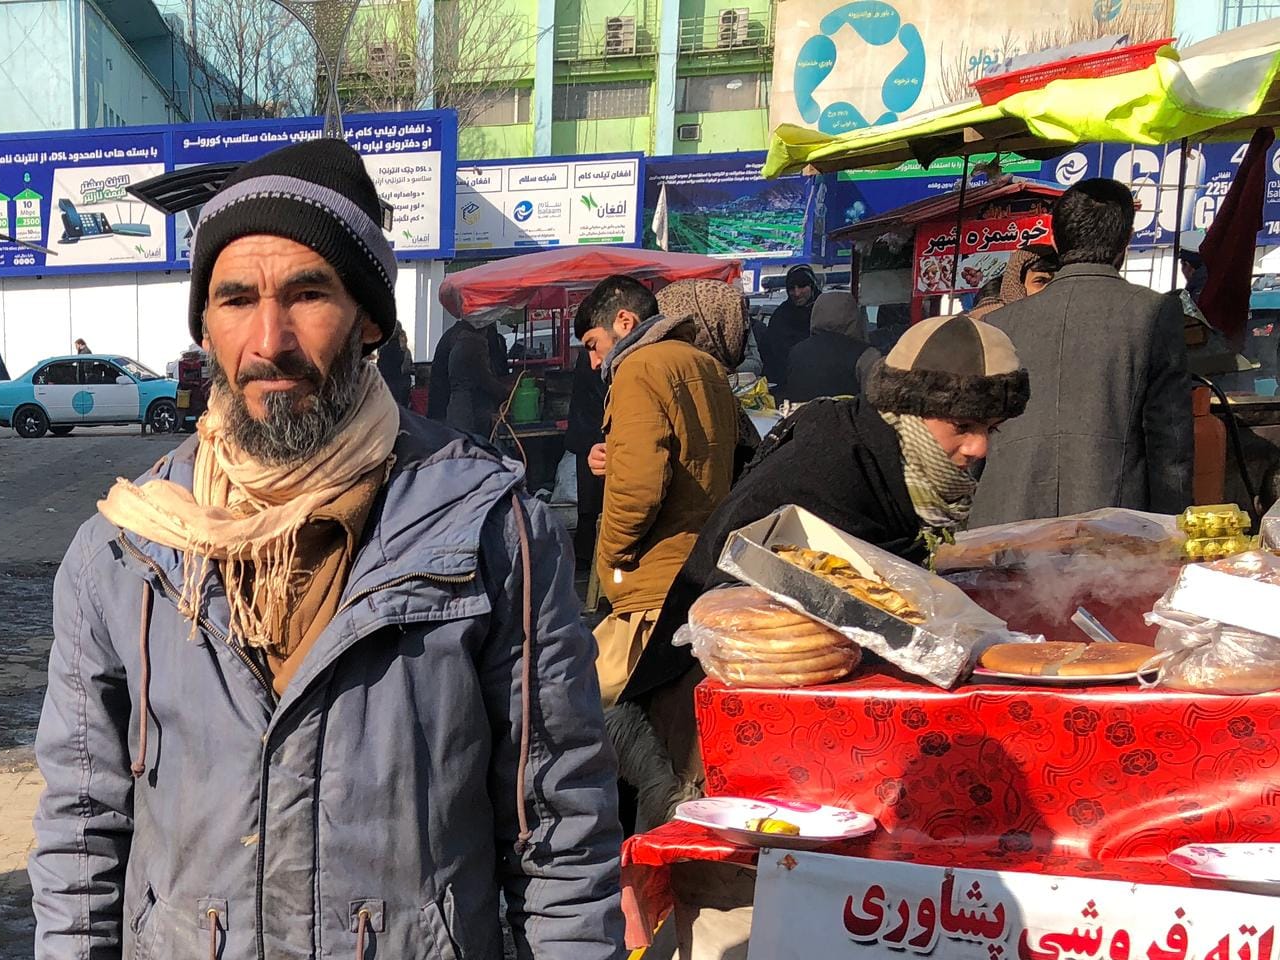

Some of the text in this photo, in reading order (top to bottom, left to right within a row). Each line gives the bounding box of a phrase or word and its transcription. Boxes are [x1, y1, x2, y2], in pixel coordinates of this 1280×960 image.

[260, 131, 288, 142] خدمات
[355, 127, 373, 139] کام
[398, 124, 425, 137] افغان
[362, 140, 383, 153] لپاره
[385, 139, 421, 151] دفترونو
[422, 138, 432, 149] او
[39, 152, 47, 164] از
[68, 149, 103, 162] نامحدود
[126, 147, 149, 158] بسته
[150, 146, 158, 158] با
[928, 163, 949, 171] استفاد
[519, 173, 557, 184] شبکه سلام
[578, 172, 592, 182] کام
[611, 170, 632, 180] افغان
[80, 178, 105, 194] بیشتر
[471, 177, 491, 187] افغان
[1114, 148, 1207, 233] 60
[23, 201, 33, 209] 10
[1194, 195, 1226, 232] G
[922, 219, 1049, 256] خوشمزه شهر
